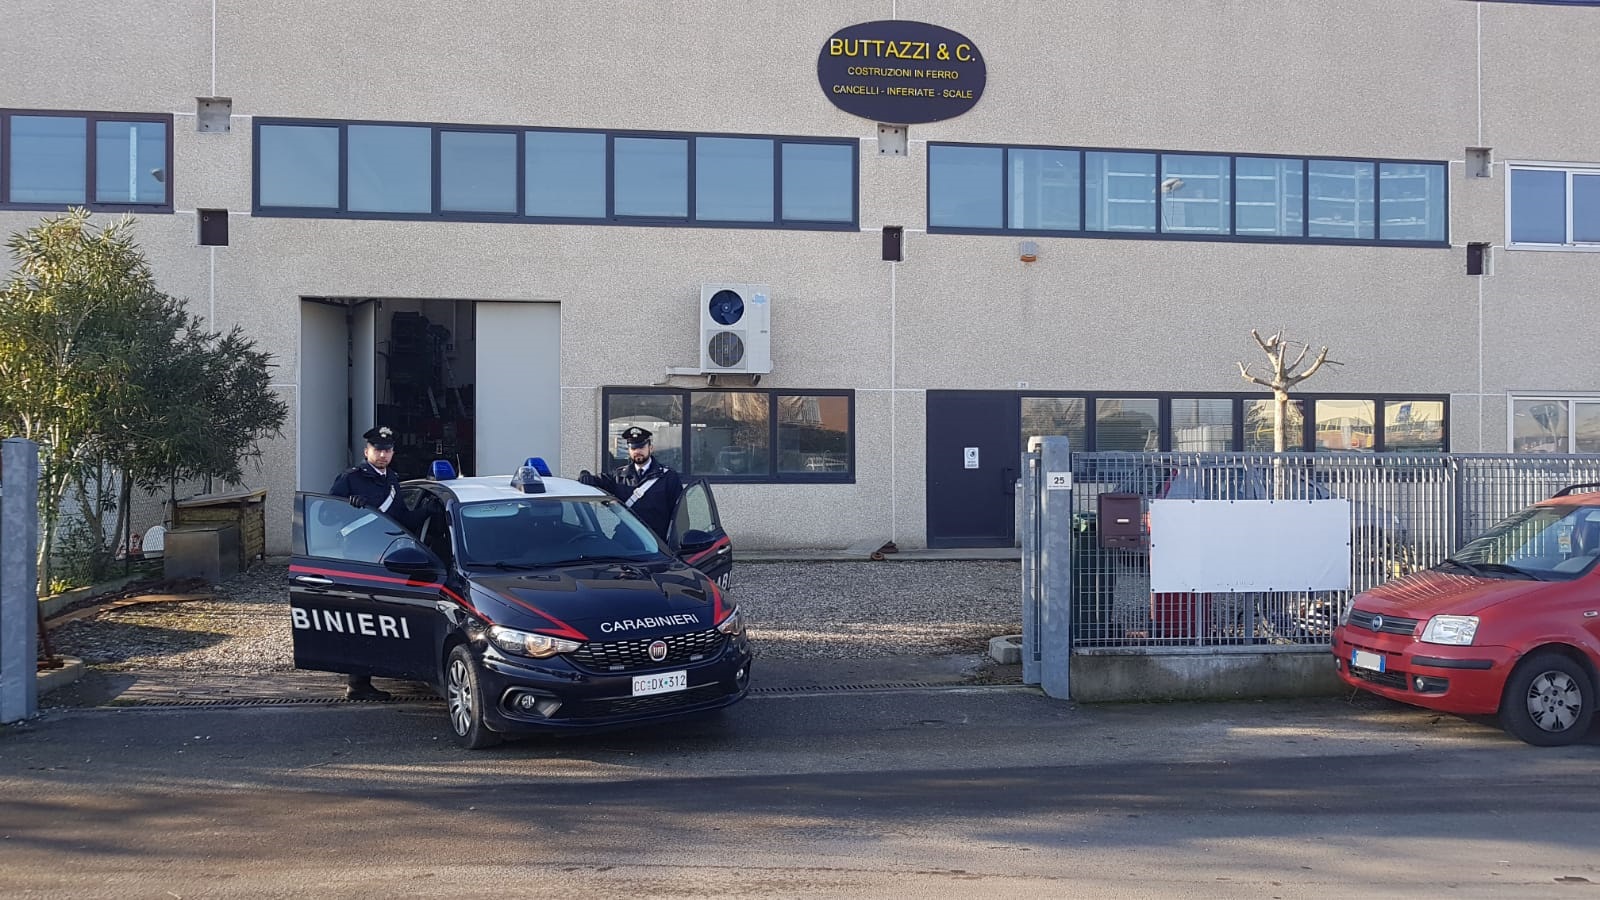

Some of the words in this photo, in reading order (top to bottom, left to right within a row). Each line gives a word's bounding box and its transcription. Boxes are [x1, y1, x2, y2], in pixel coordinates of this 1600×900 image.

[829, 38, 930, 60] BUTTAZZI
[936, 42, 950, 61] &
[956, 43, 976, 62] C.
[847, 66, 912, 78] COSTRUZIONI
[914, 69, 924, 79] IN
[926, 69, 959, 80] FERRO
[833, 84, 879, 96] CANCELLI
[886, 87, 935, 98] INFERIATE
[943, 89, 974, 100] SCALE
[1053, 476, 1065, 485] 25
[291, 607, 411, 640] BINIERI
[600, 613, 700, 634] CARABINIERI
